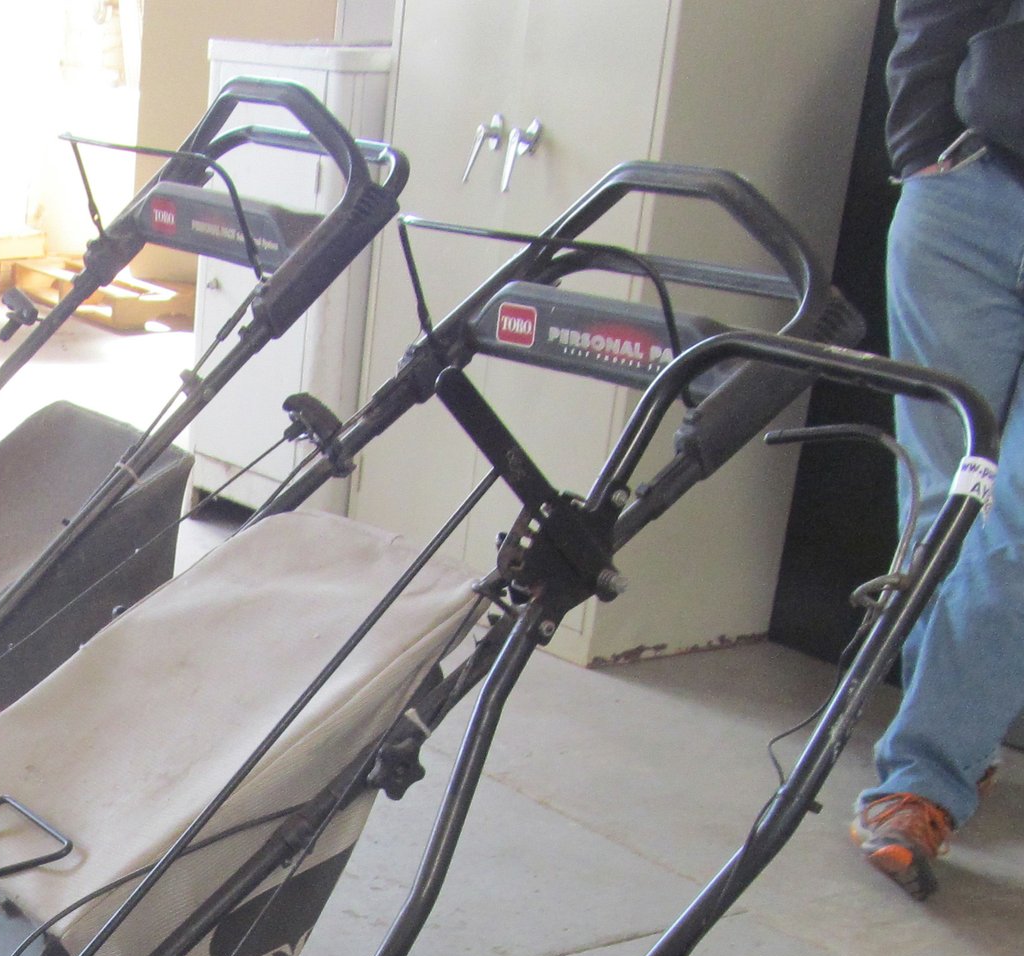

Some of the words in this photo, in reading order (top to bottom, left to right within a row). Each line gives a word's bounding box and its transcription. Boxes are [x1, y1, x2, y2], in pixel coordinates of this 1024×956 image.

[153, 208, 176, 225] TORO
[548, 326, 644, 360] PERSONAL
[648, 345, 675, 364] PA
